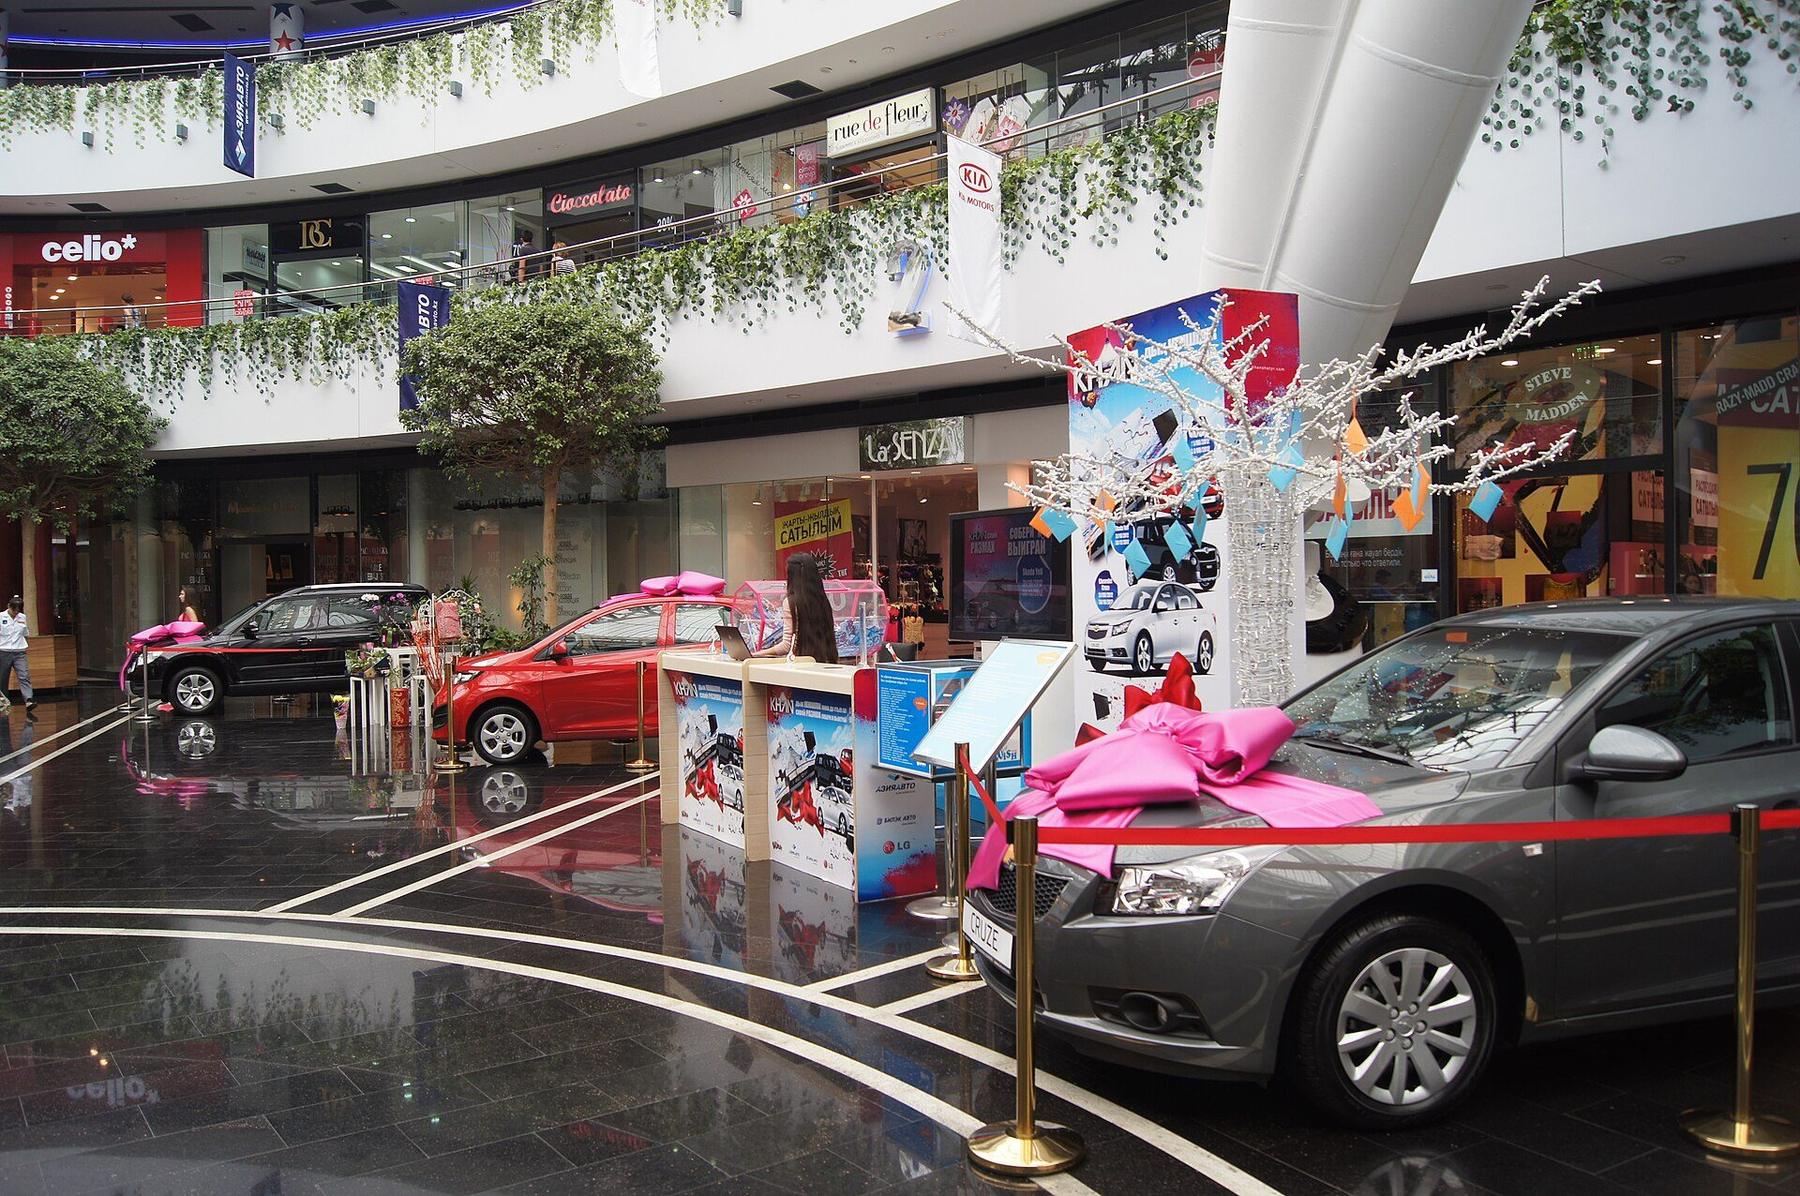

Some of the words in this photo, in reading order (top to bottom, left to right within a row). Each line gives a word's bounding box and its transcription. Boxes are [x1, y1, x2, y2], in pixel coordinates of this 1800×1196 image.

[235, 66, 245, 140] АЗИЯАВТО
[834, 121, 859, 141] rue
[863, 110, 881, 132] de
[885, 102, 924, 136] fleur
[964, 168, 987, 189] KIA
[550, 184, 632, 214] Cioccolato
[967, 197, 994, 212] MOTORS
[1525, 367, 1572, 392] STEVE
[1526, 391, 1589, 421] MADDEN
[866, 435, 888, 462] La
[781, 516, 842, 544] САТЫЛЫМ
[1747, 467, 1800, 580] 7
[770, 696, 794, 714] KHAN
[875, 782, 916, 793] АЗИЯАВТО
[897, 840, 911, 851] LG
[971, 912, 999, 951] CRUZE
